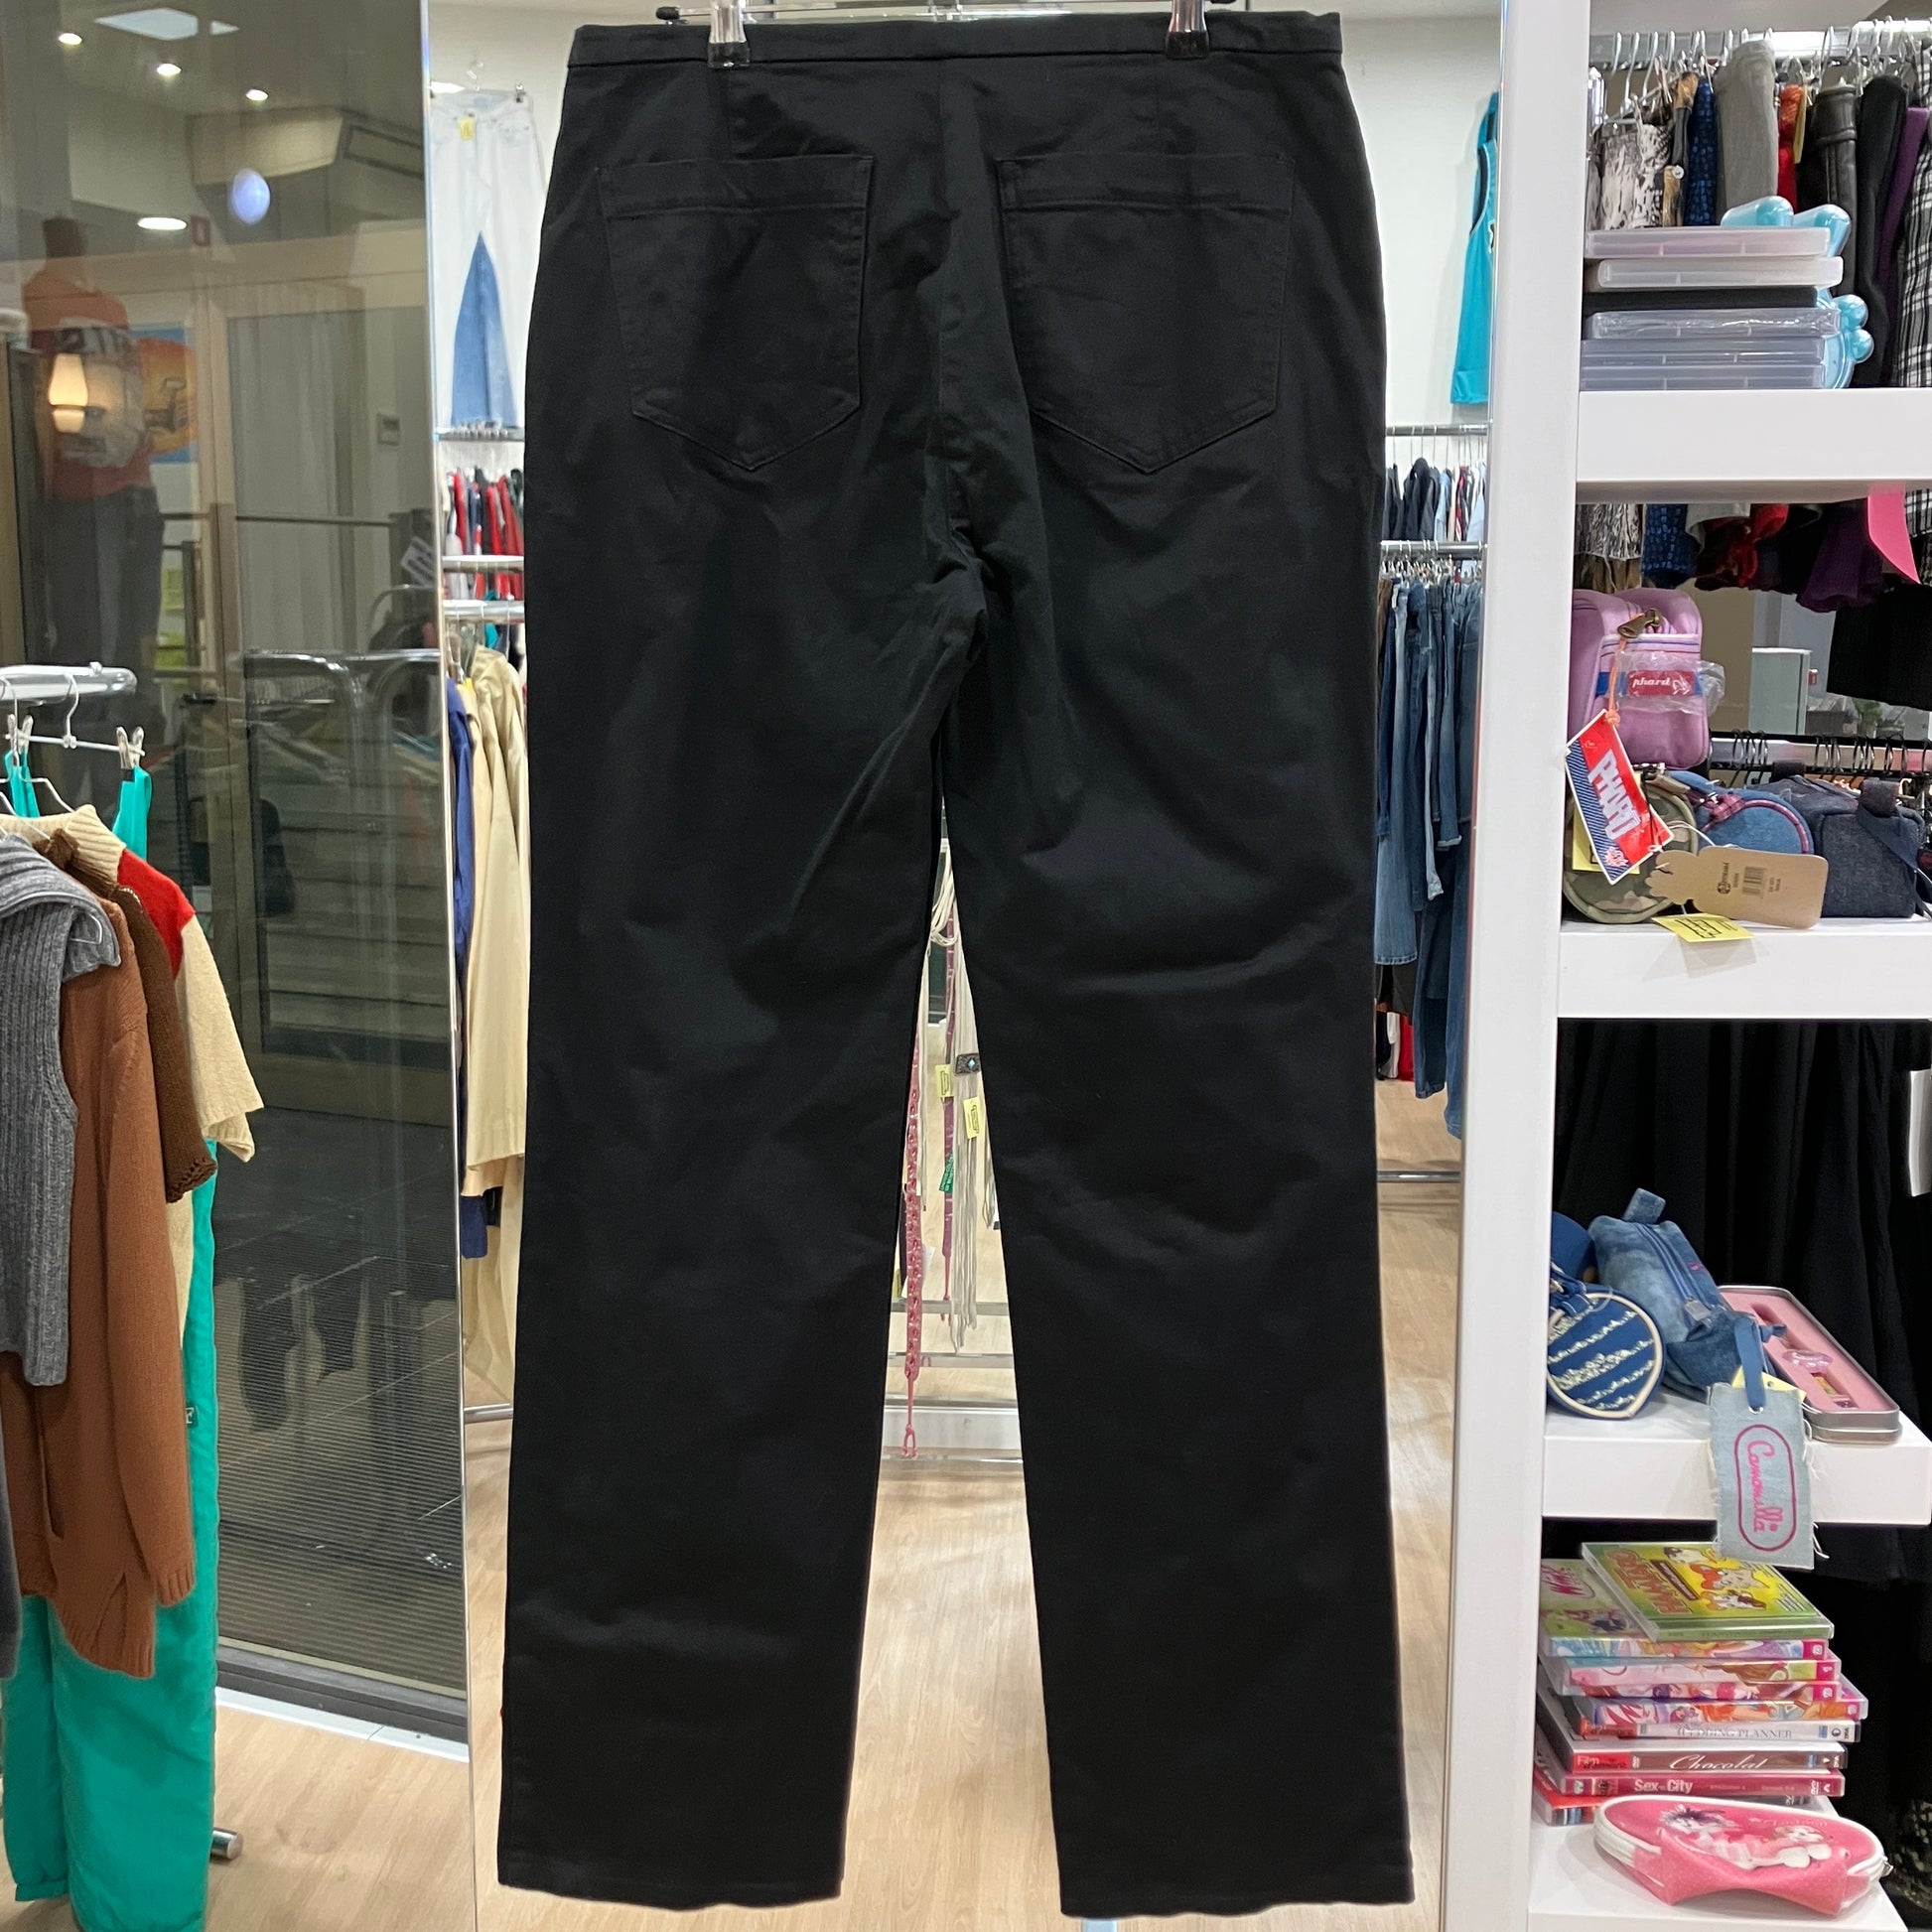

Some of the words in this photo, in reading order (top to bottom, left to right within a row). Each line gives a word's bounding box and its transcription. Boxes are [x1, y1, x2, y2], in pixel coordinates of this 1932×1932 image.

[1632, 677, 1671, 688] phard
[1587, 749, 1641, 841] PHARD
[1738, 1728, 1792, 1739] PLANNER
[1669, 1753, 1769, 1769] Chocolat
[1634, 1779, 1659, 1793] Sex
[1667, 1778, 1694, 1795] City
